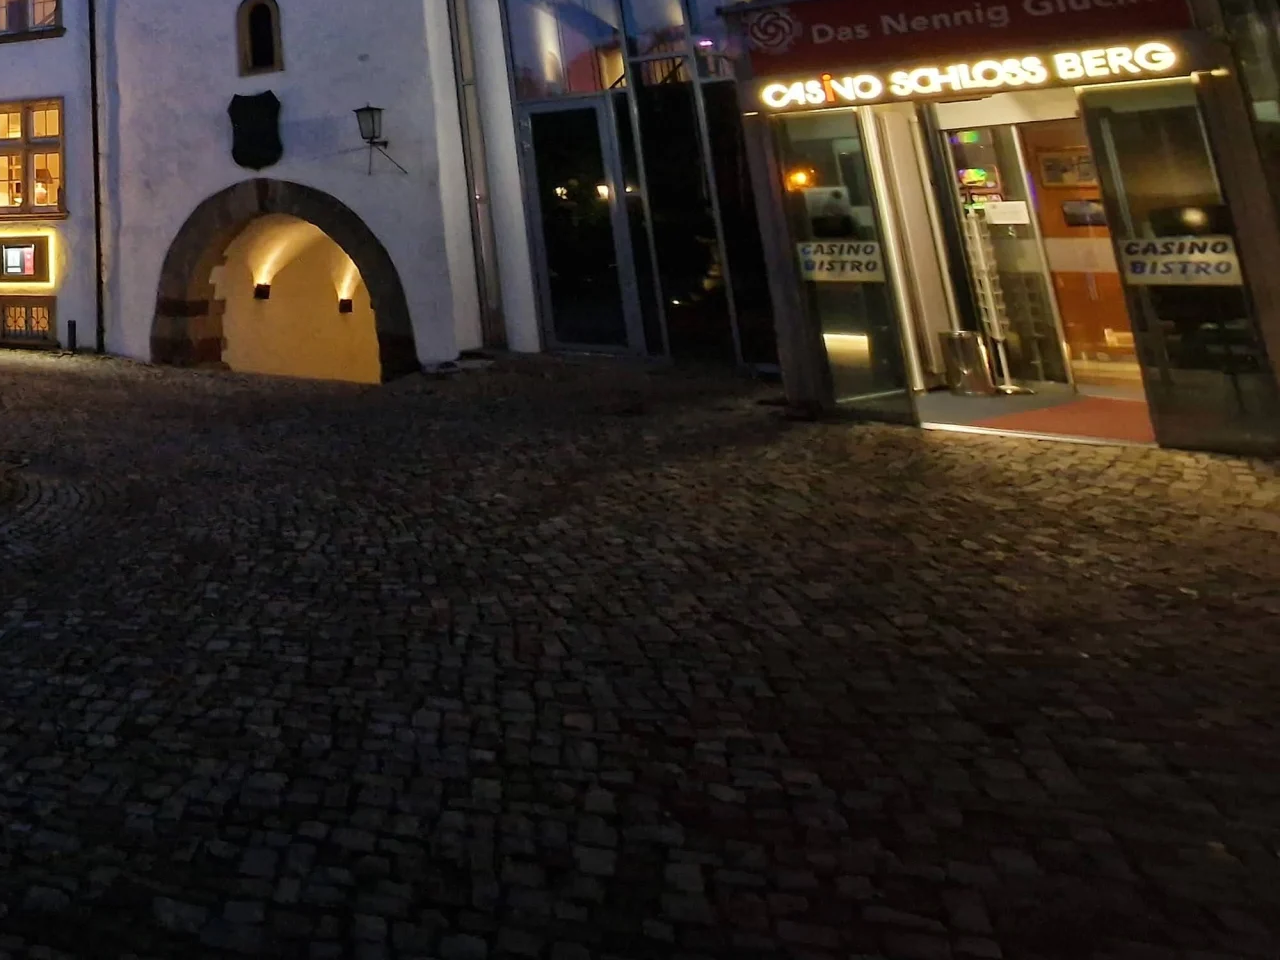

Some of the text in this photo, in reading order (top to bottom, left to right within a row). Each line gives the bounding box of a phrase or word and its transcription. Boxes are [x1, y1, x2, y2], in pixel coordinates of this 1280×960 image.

[811, 22, 870, 45] Das
[880, 2, 1010, 36] Nennig
[889, 55, 1048, 96] SCHLOSS
[1054, 41, 1177, 81] BERG
[801, 243, 875, 256] CASINO
[1124, 241, 1229, 256] CASINO
[804, 260, 879, 272] BISTRO
[1129, 261, 1233, 276] BISTRO
